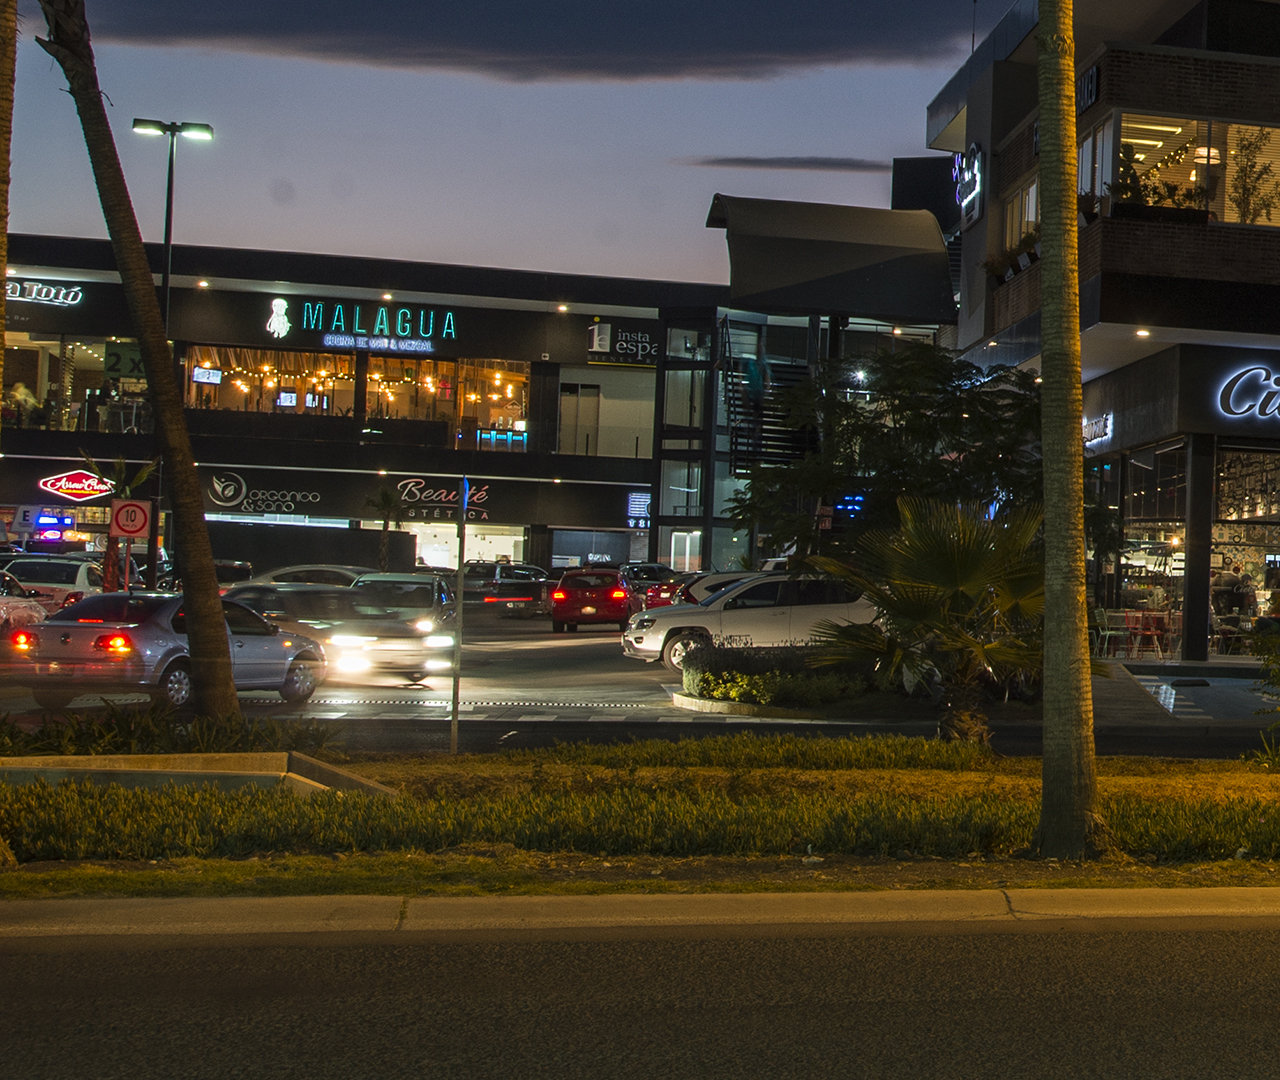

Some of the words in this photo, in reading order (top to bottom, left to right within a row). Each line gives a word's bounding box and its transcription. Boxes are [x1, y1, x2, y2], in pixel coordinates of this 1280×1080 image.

[302, 302, 457, 339] MALAGUA
[617, 328, 650, 342] insta
[125, 509, 137, 522] 10
[404, 508, 489, 520] STÉTCA
